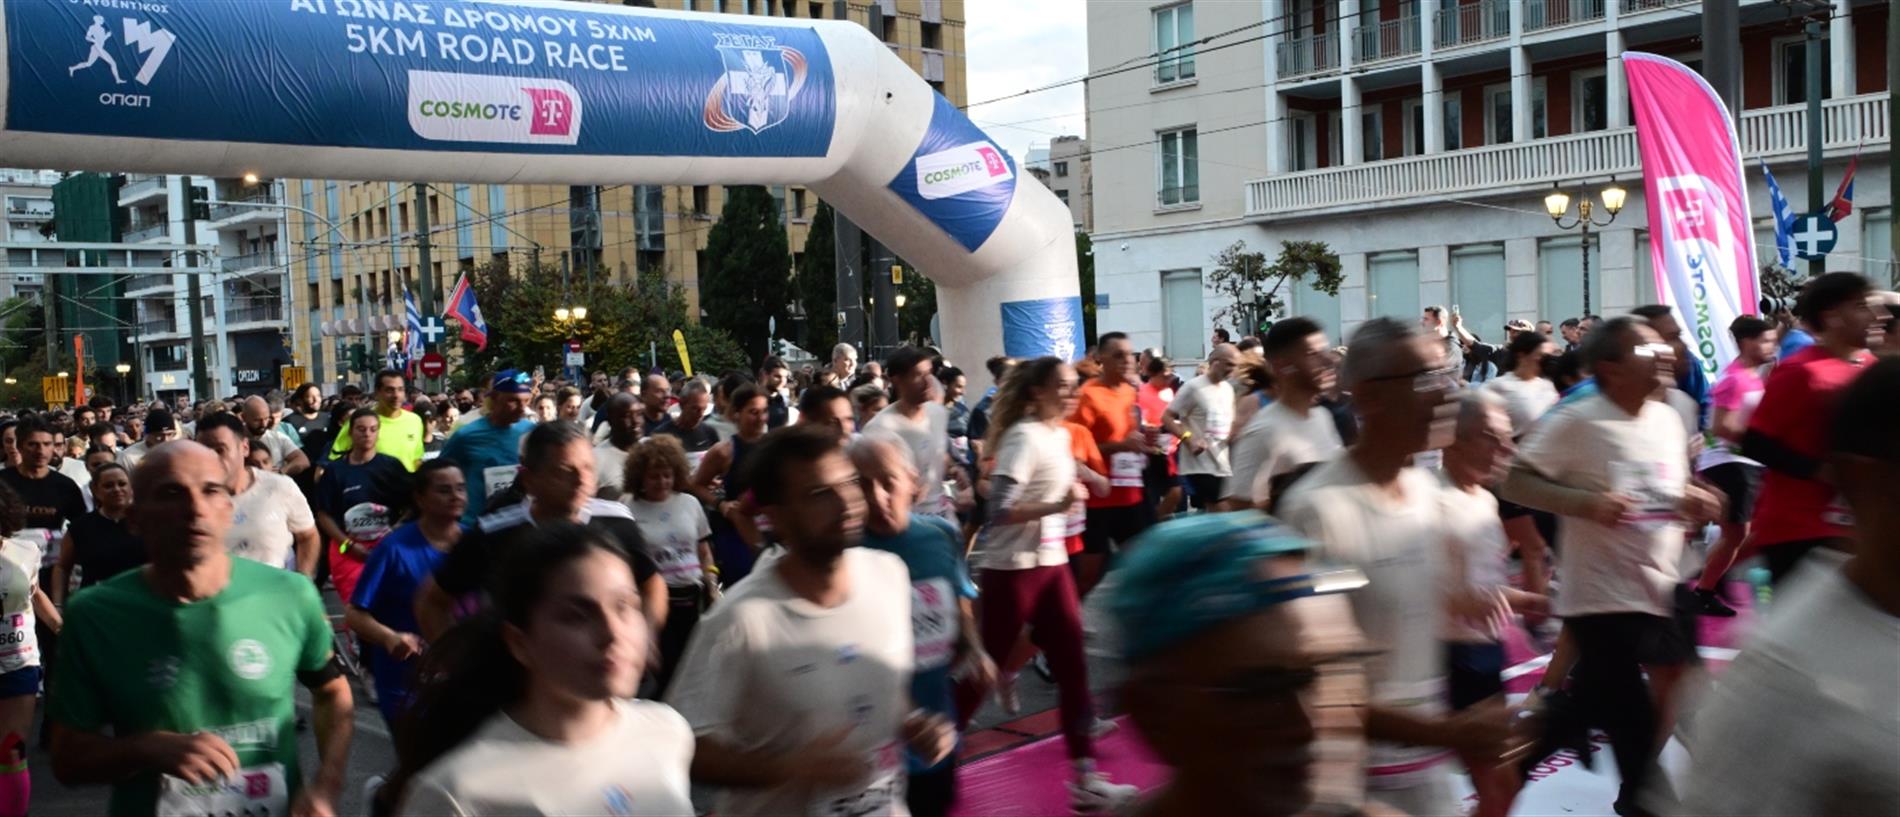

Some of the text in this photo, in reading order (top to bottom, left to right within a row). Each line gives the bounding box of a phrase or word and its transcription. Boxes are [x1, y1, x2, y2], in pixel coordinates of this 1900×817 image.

[444, 7, 578, 37] ΔΡΟΜΟΥ
[345, 23, 629, 71] 5KM ROAD RACE
[419, 100, 522, 121] COSMOTE
[924, 161, 982, 184] COSMOTE
